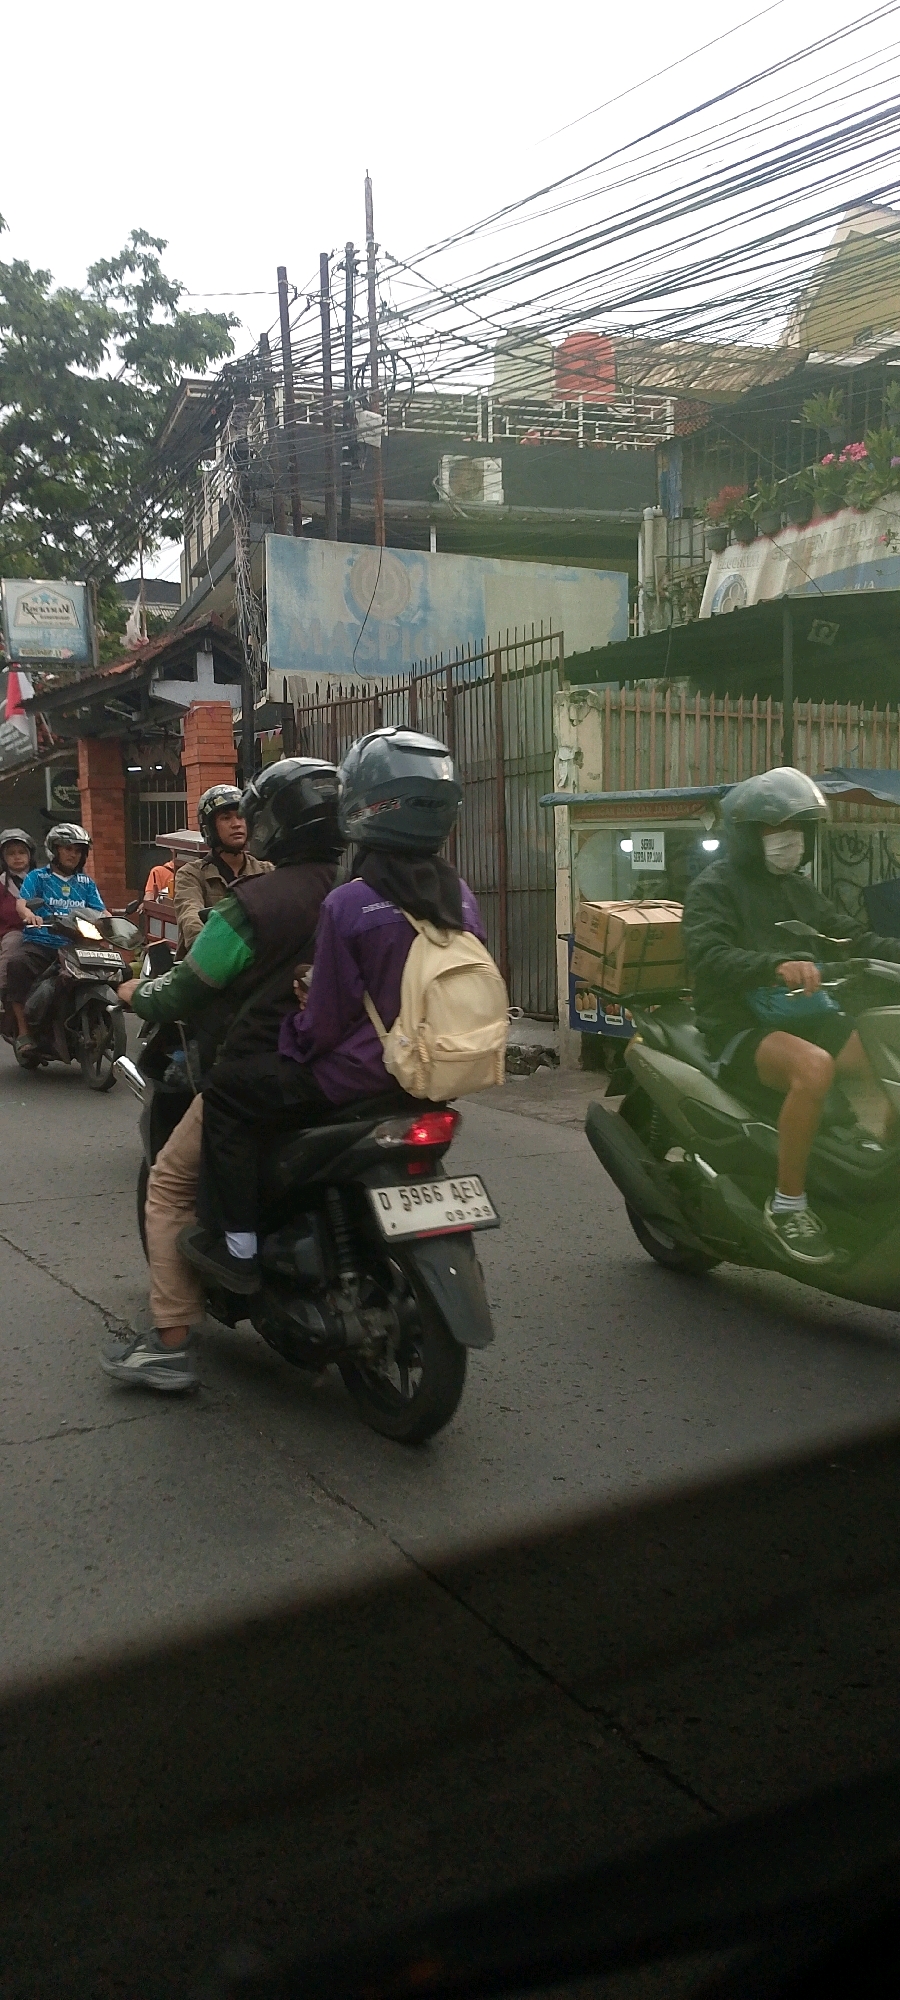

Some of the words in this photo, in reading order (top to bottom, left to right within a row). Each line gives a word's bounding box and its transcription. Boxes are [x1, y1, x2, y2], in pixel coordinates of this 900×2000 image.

[49, 897, 86, 908] Indofood
[378, 1192, 392, 1210] D
[399, 1185, 444, 1206] 5966
[450, 1179, 483, 1201] AEU
[445, 1205, 491, 1222] 09-29
